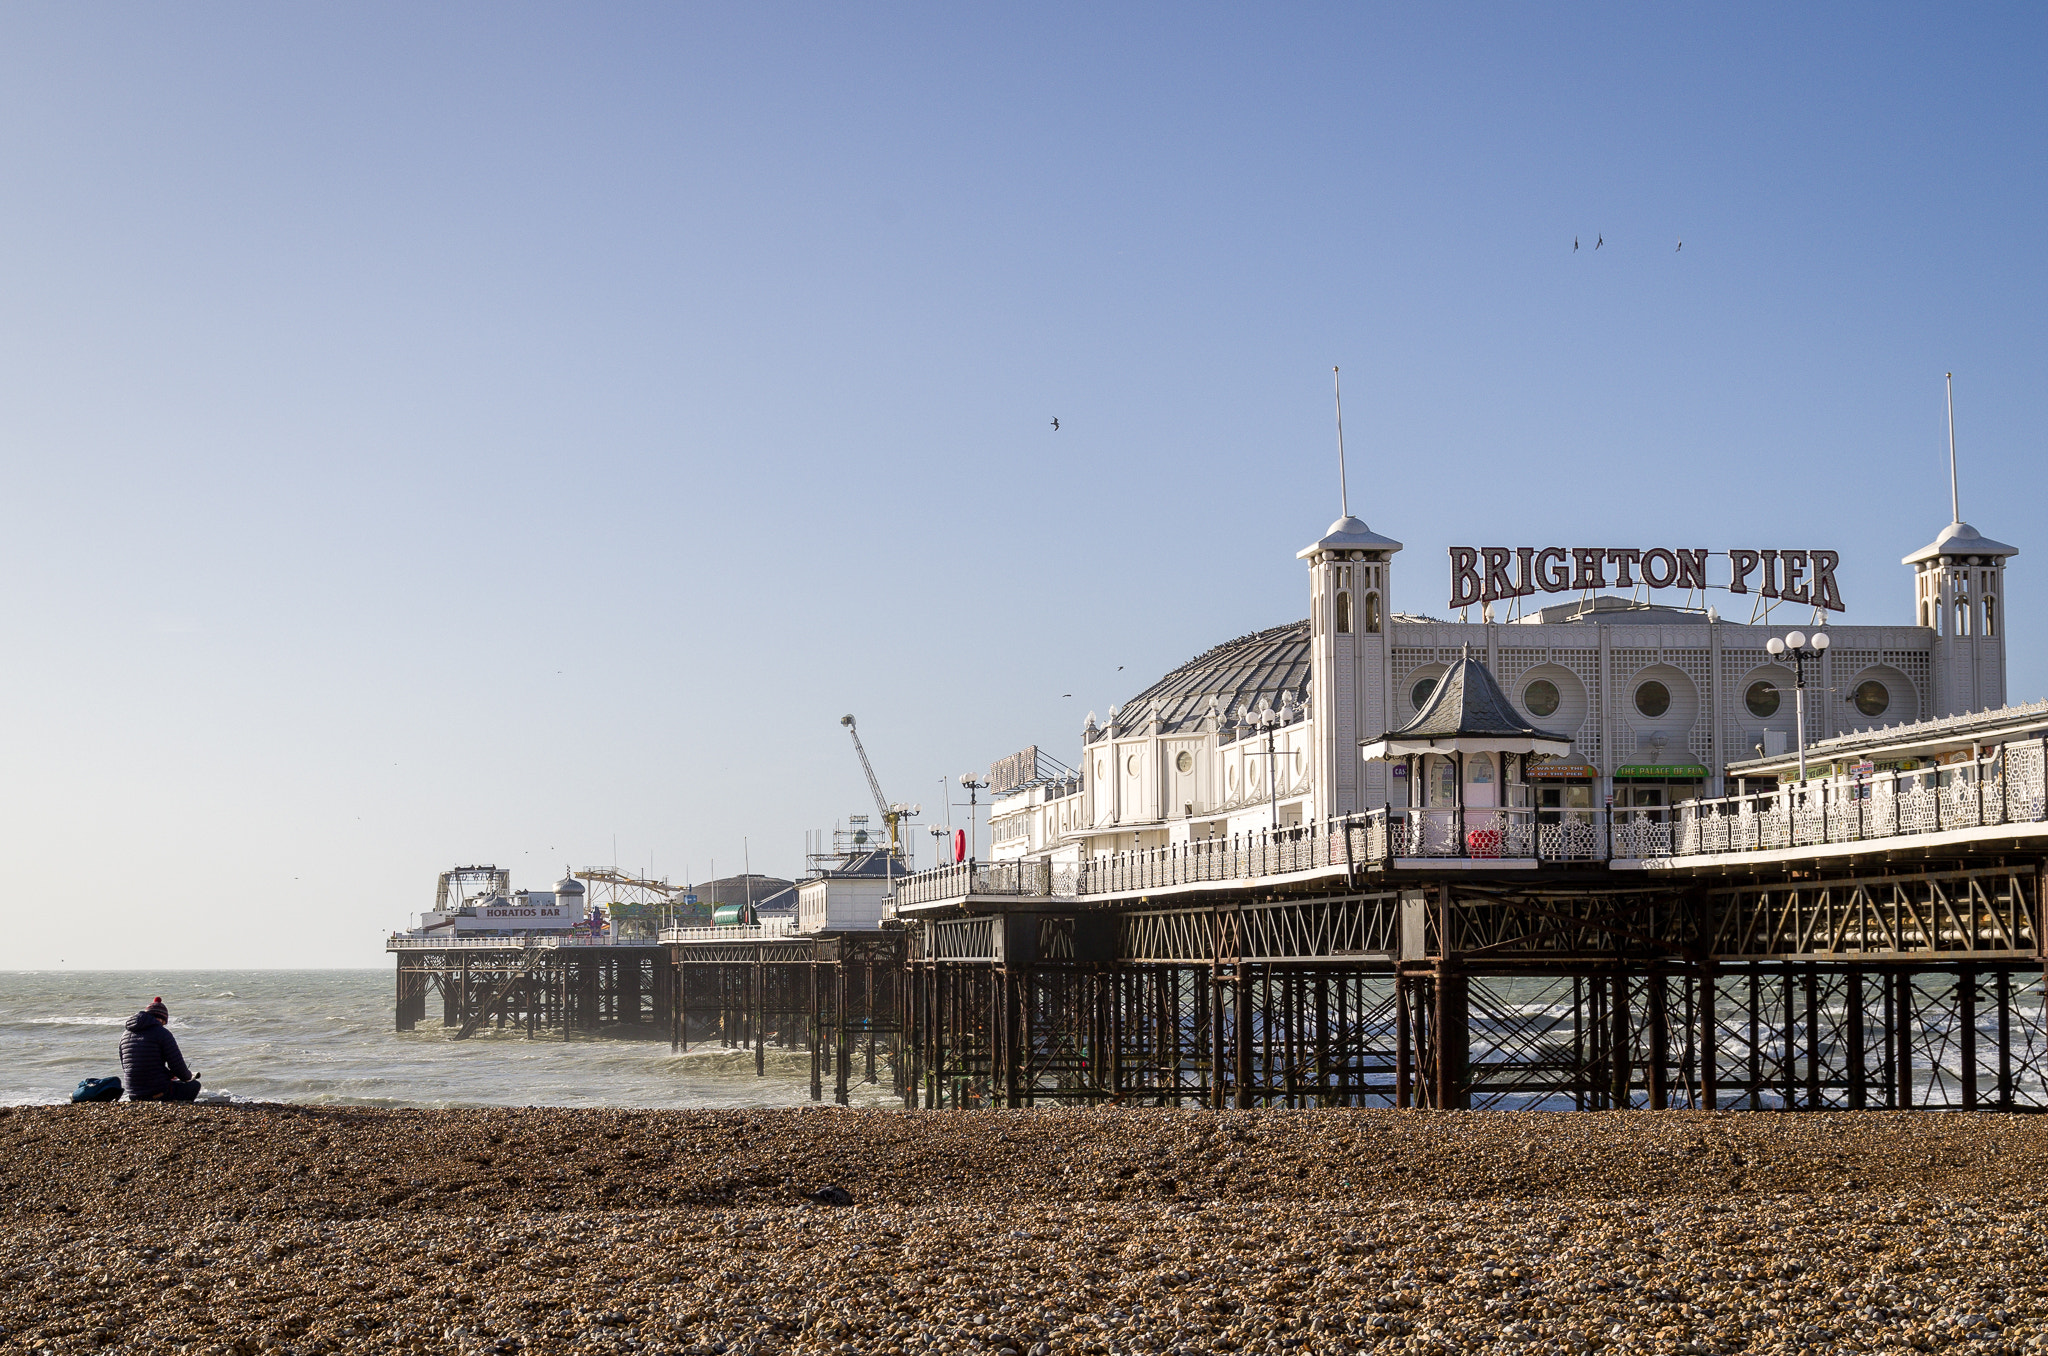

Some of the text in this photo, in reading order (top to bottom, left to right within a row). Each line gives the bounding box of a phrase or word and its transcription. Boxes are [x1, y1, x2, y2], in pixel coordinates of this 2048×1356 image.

[1449, 547, 1845, 612] BRIGHTON PIER
[1621, 767, 1704, 775] THE PALACE OF FUN
[487, 909, 537, 917] HORATIOS
